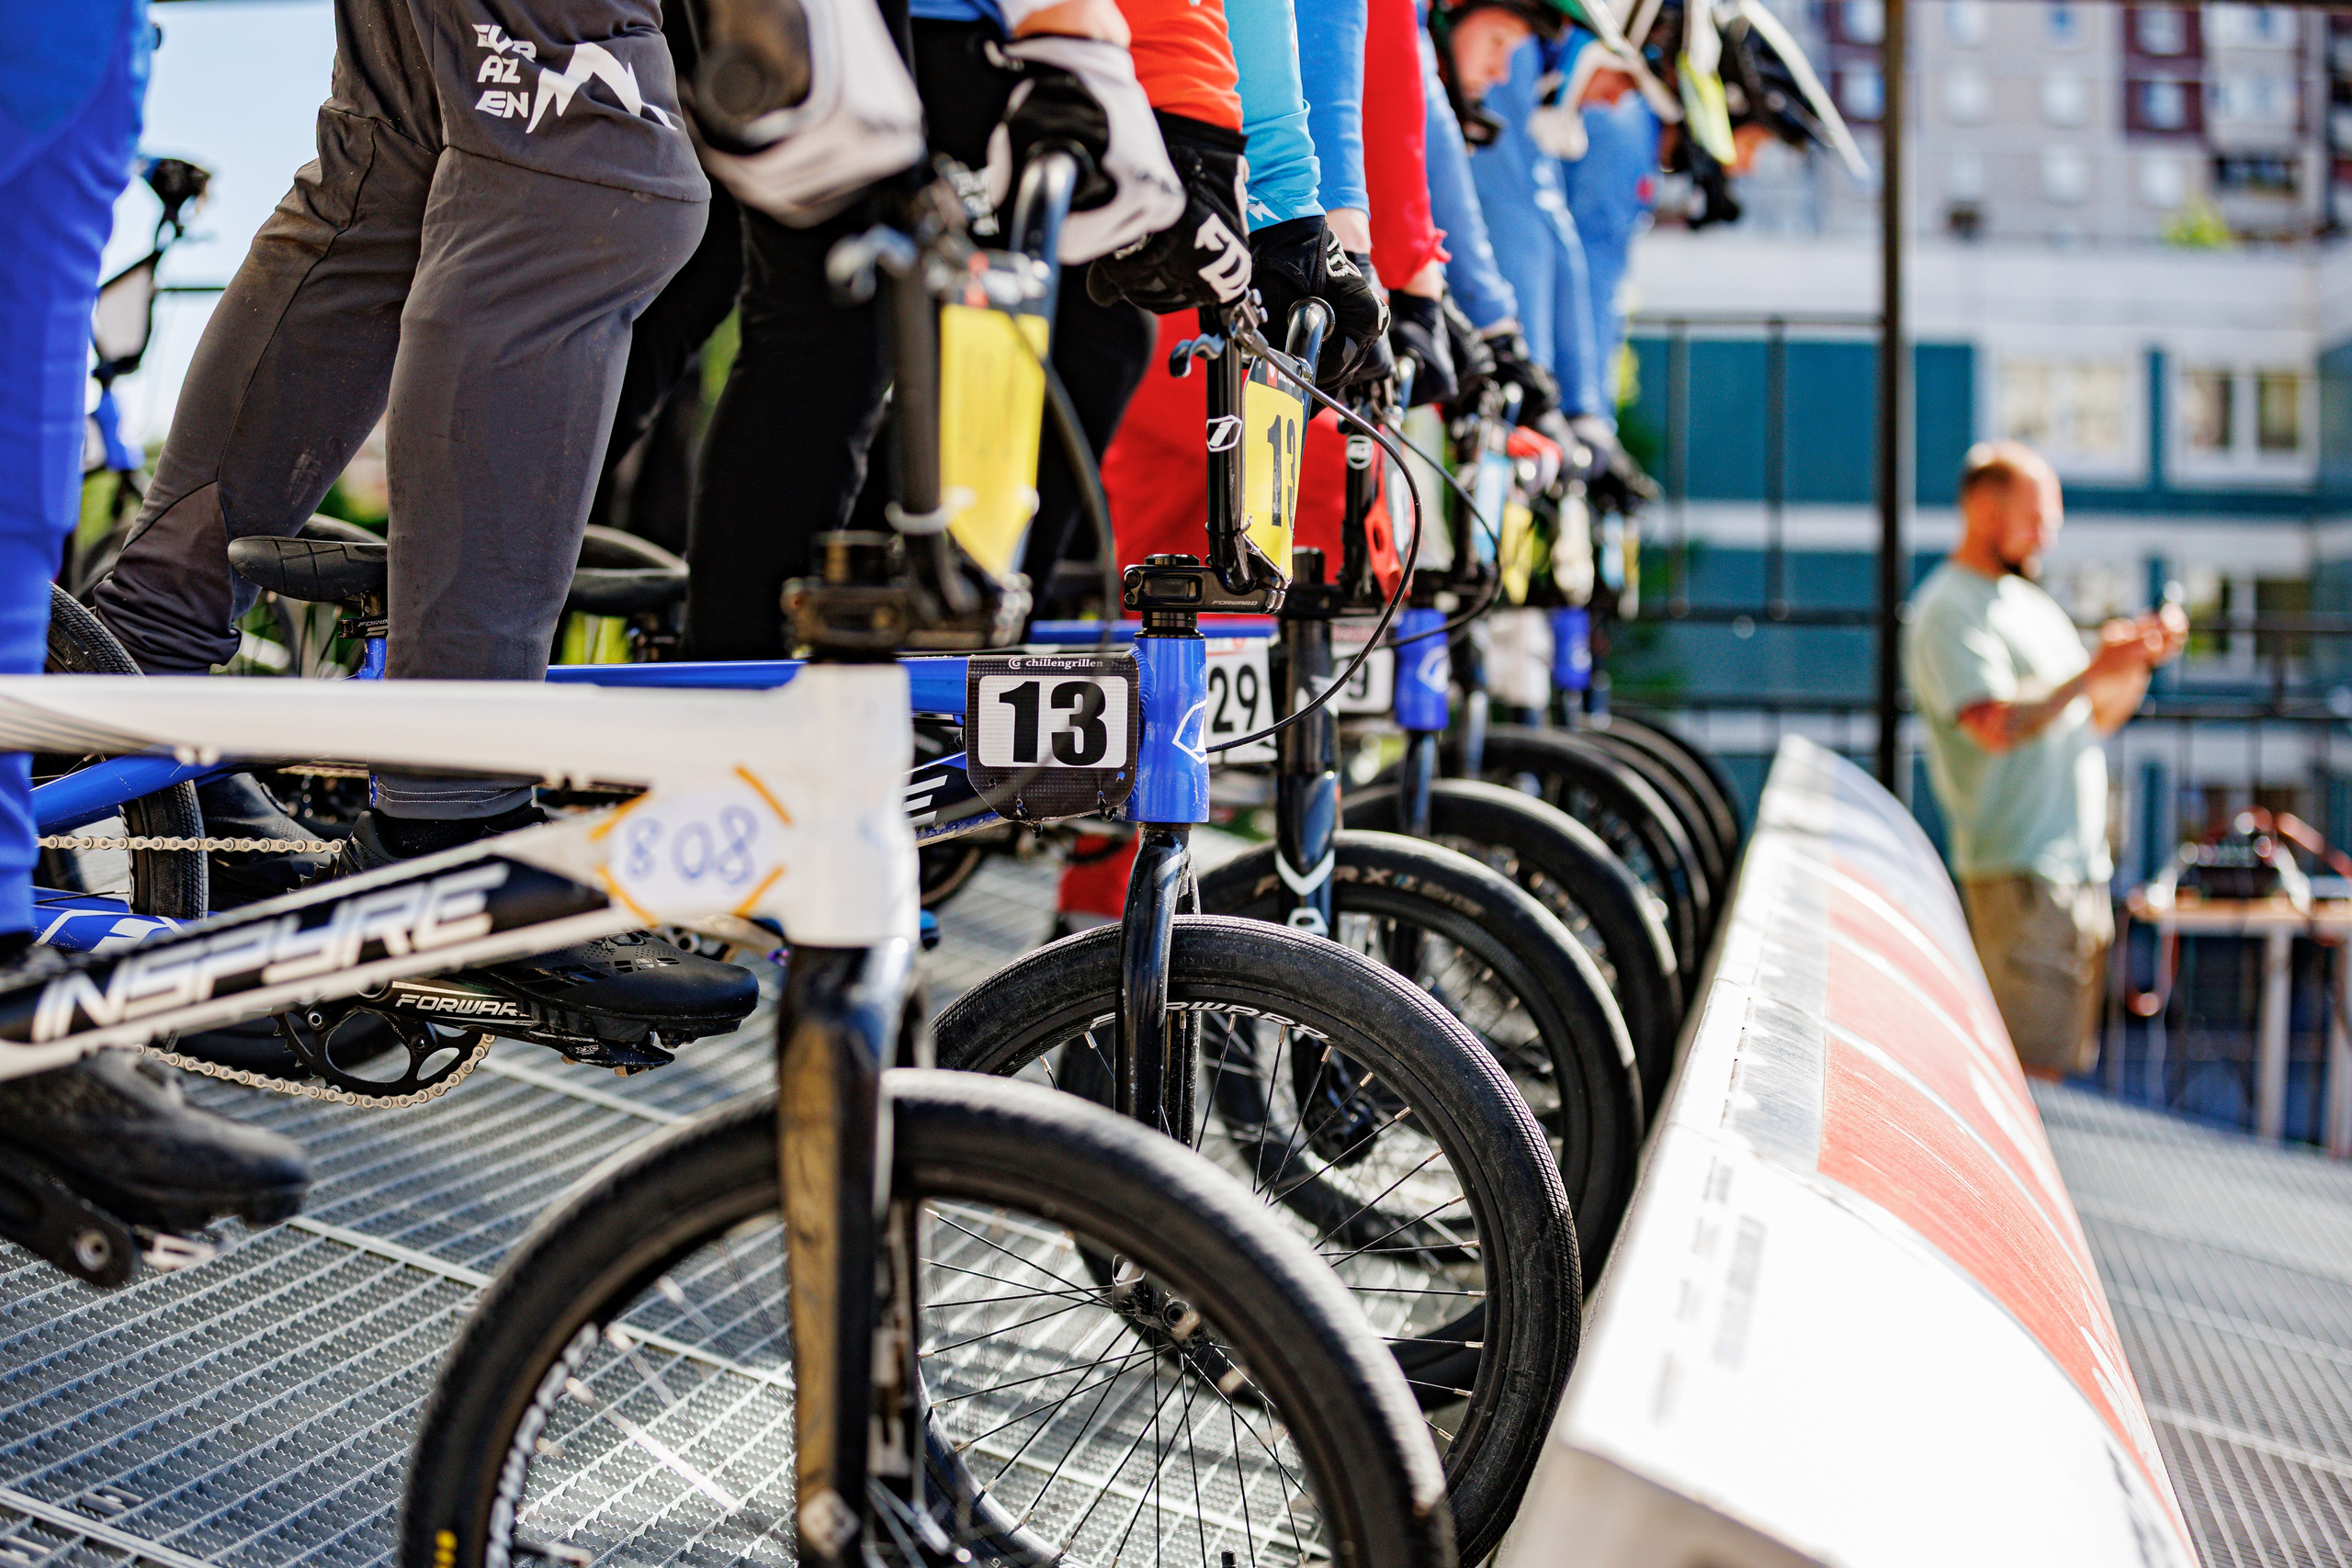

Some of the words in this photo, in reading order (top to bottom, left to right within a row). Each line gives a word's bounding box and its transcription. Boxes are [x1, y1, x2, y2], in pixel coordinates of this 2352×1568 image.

[474, 90, 529, 118] EN
[477, 55, 521, 84] AZ
[1267, 414, 1295, 533] 13
[1025, 658, 1103, 670] chillengrillen
[1209, 664, 1259, 733] 29
[999, 681, 1108, 766] 13
[625, 804, 760, 895] 808
[31, 862, 511, 1043] INSPYRE
[395, 993, 530, 1018] FORWAR
